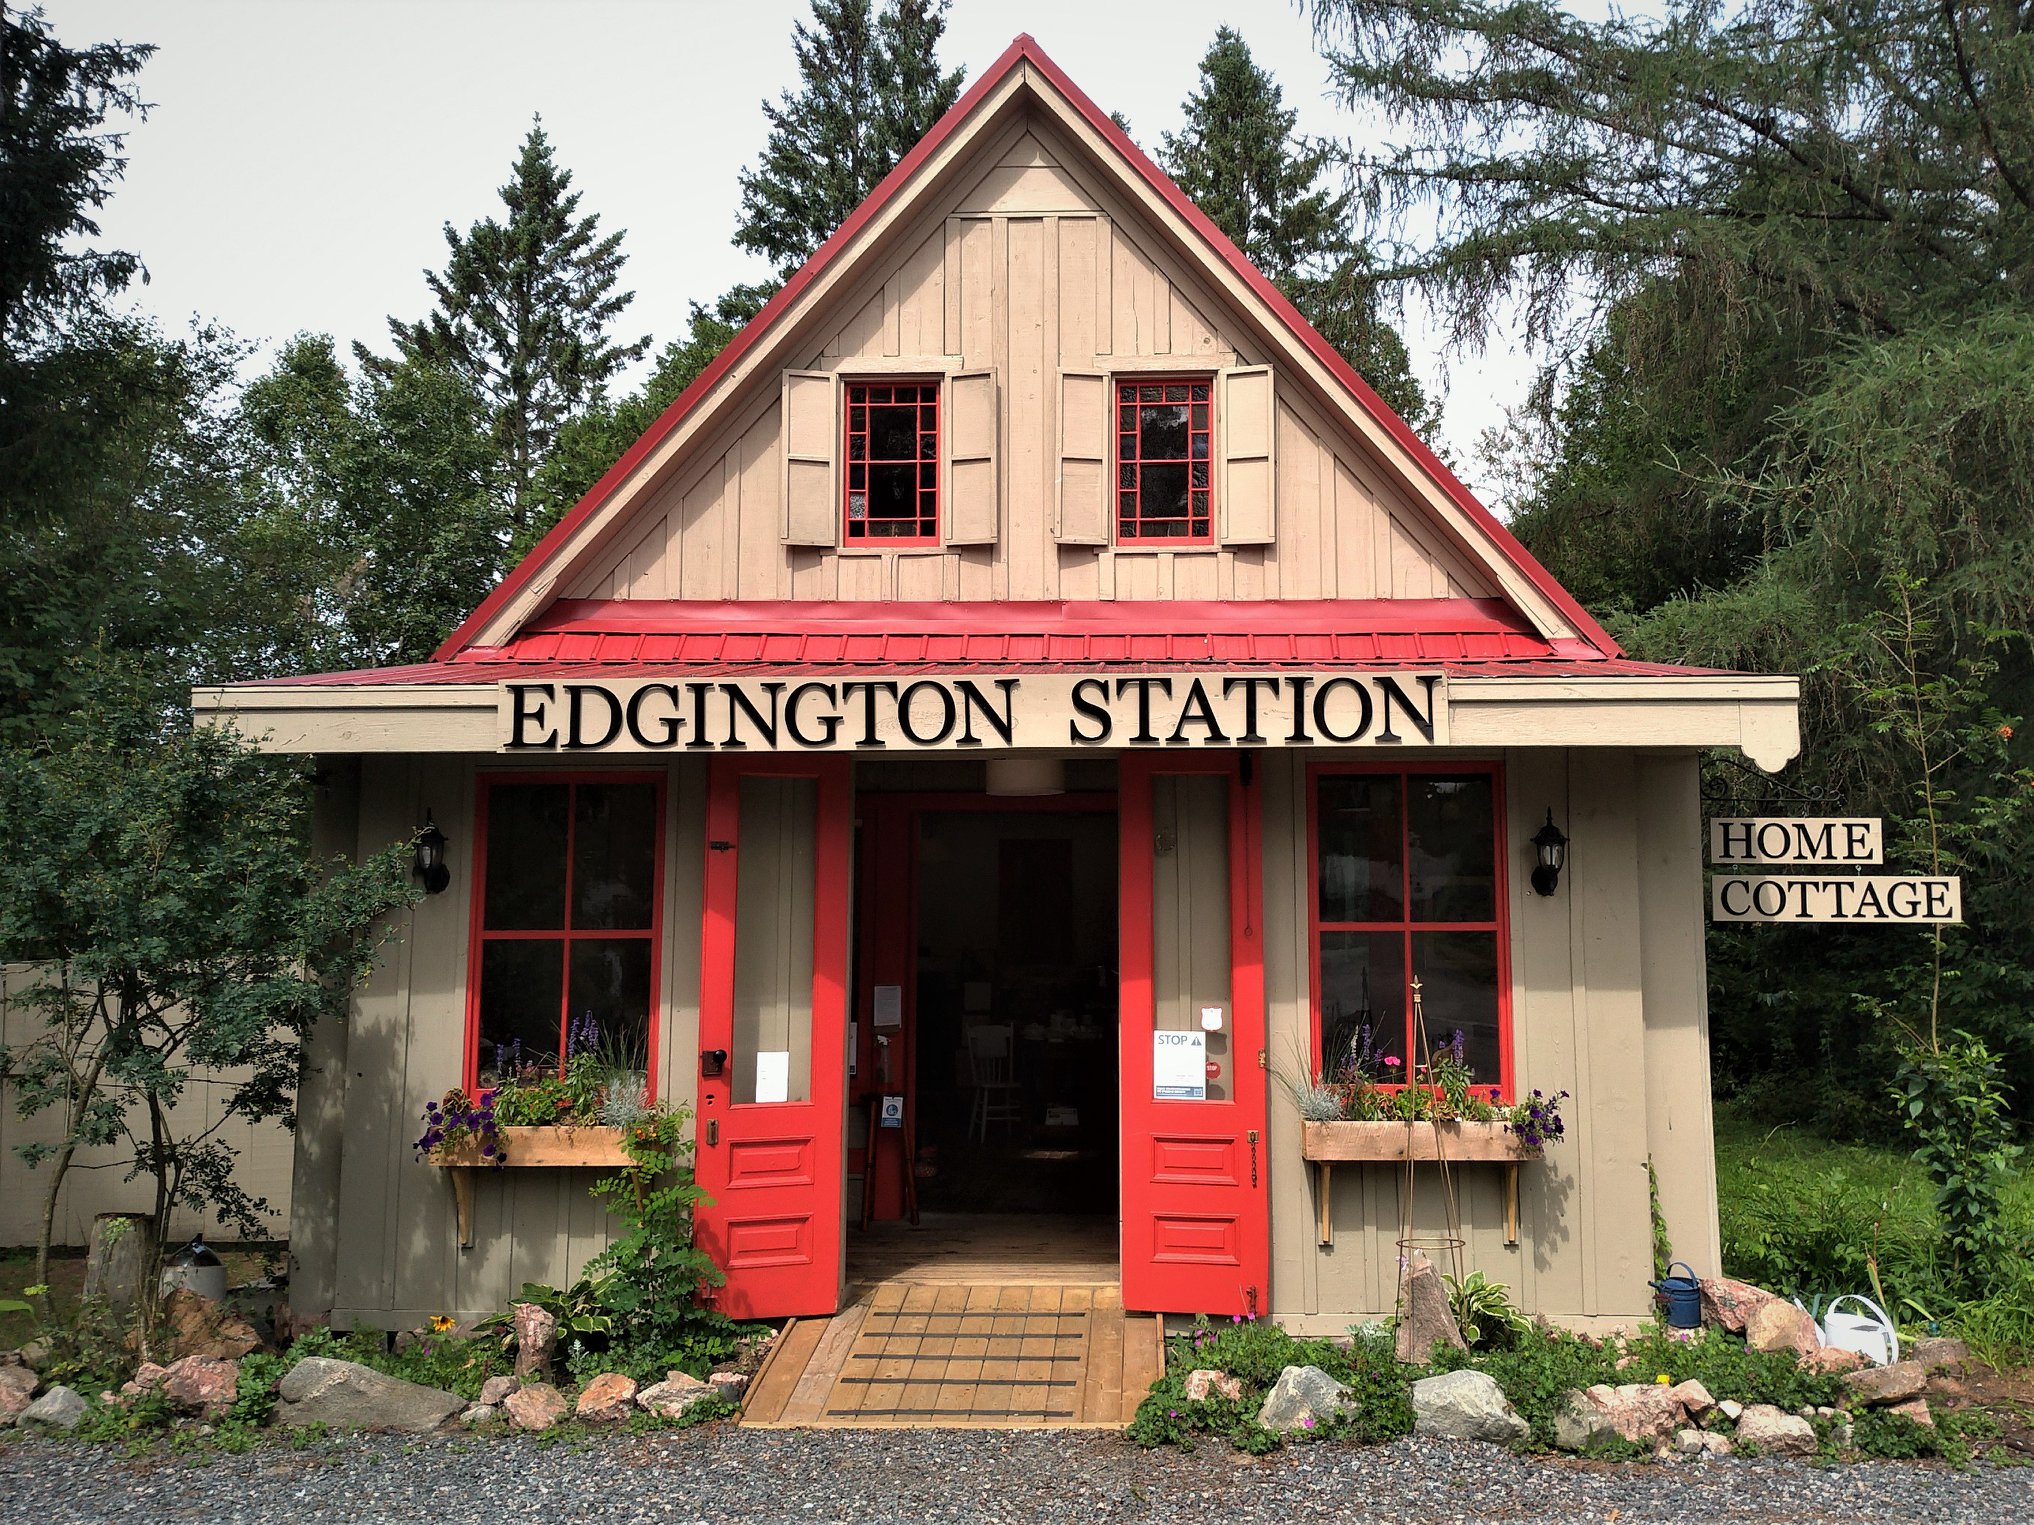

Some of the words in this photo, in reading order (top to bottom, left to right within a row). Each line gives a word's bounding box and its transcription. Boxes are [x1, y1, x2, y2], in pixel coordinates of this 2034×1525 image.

[505, 678, 1020, 749] EDGINGTON
[1069, 675, 1443, 744] STATION
[1718, 822, 1874, 861] HOME
[1720, 879, 1953, 919] COTTAGE
[1158, 1034, 1188, 1045] STOP
